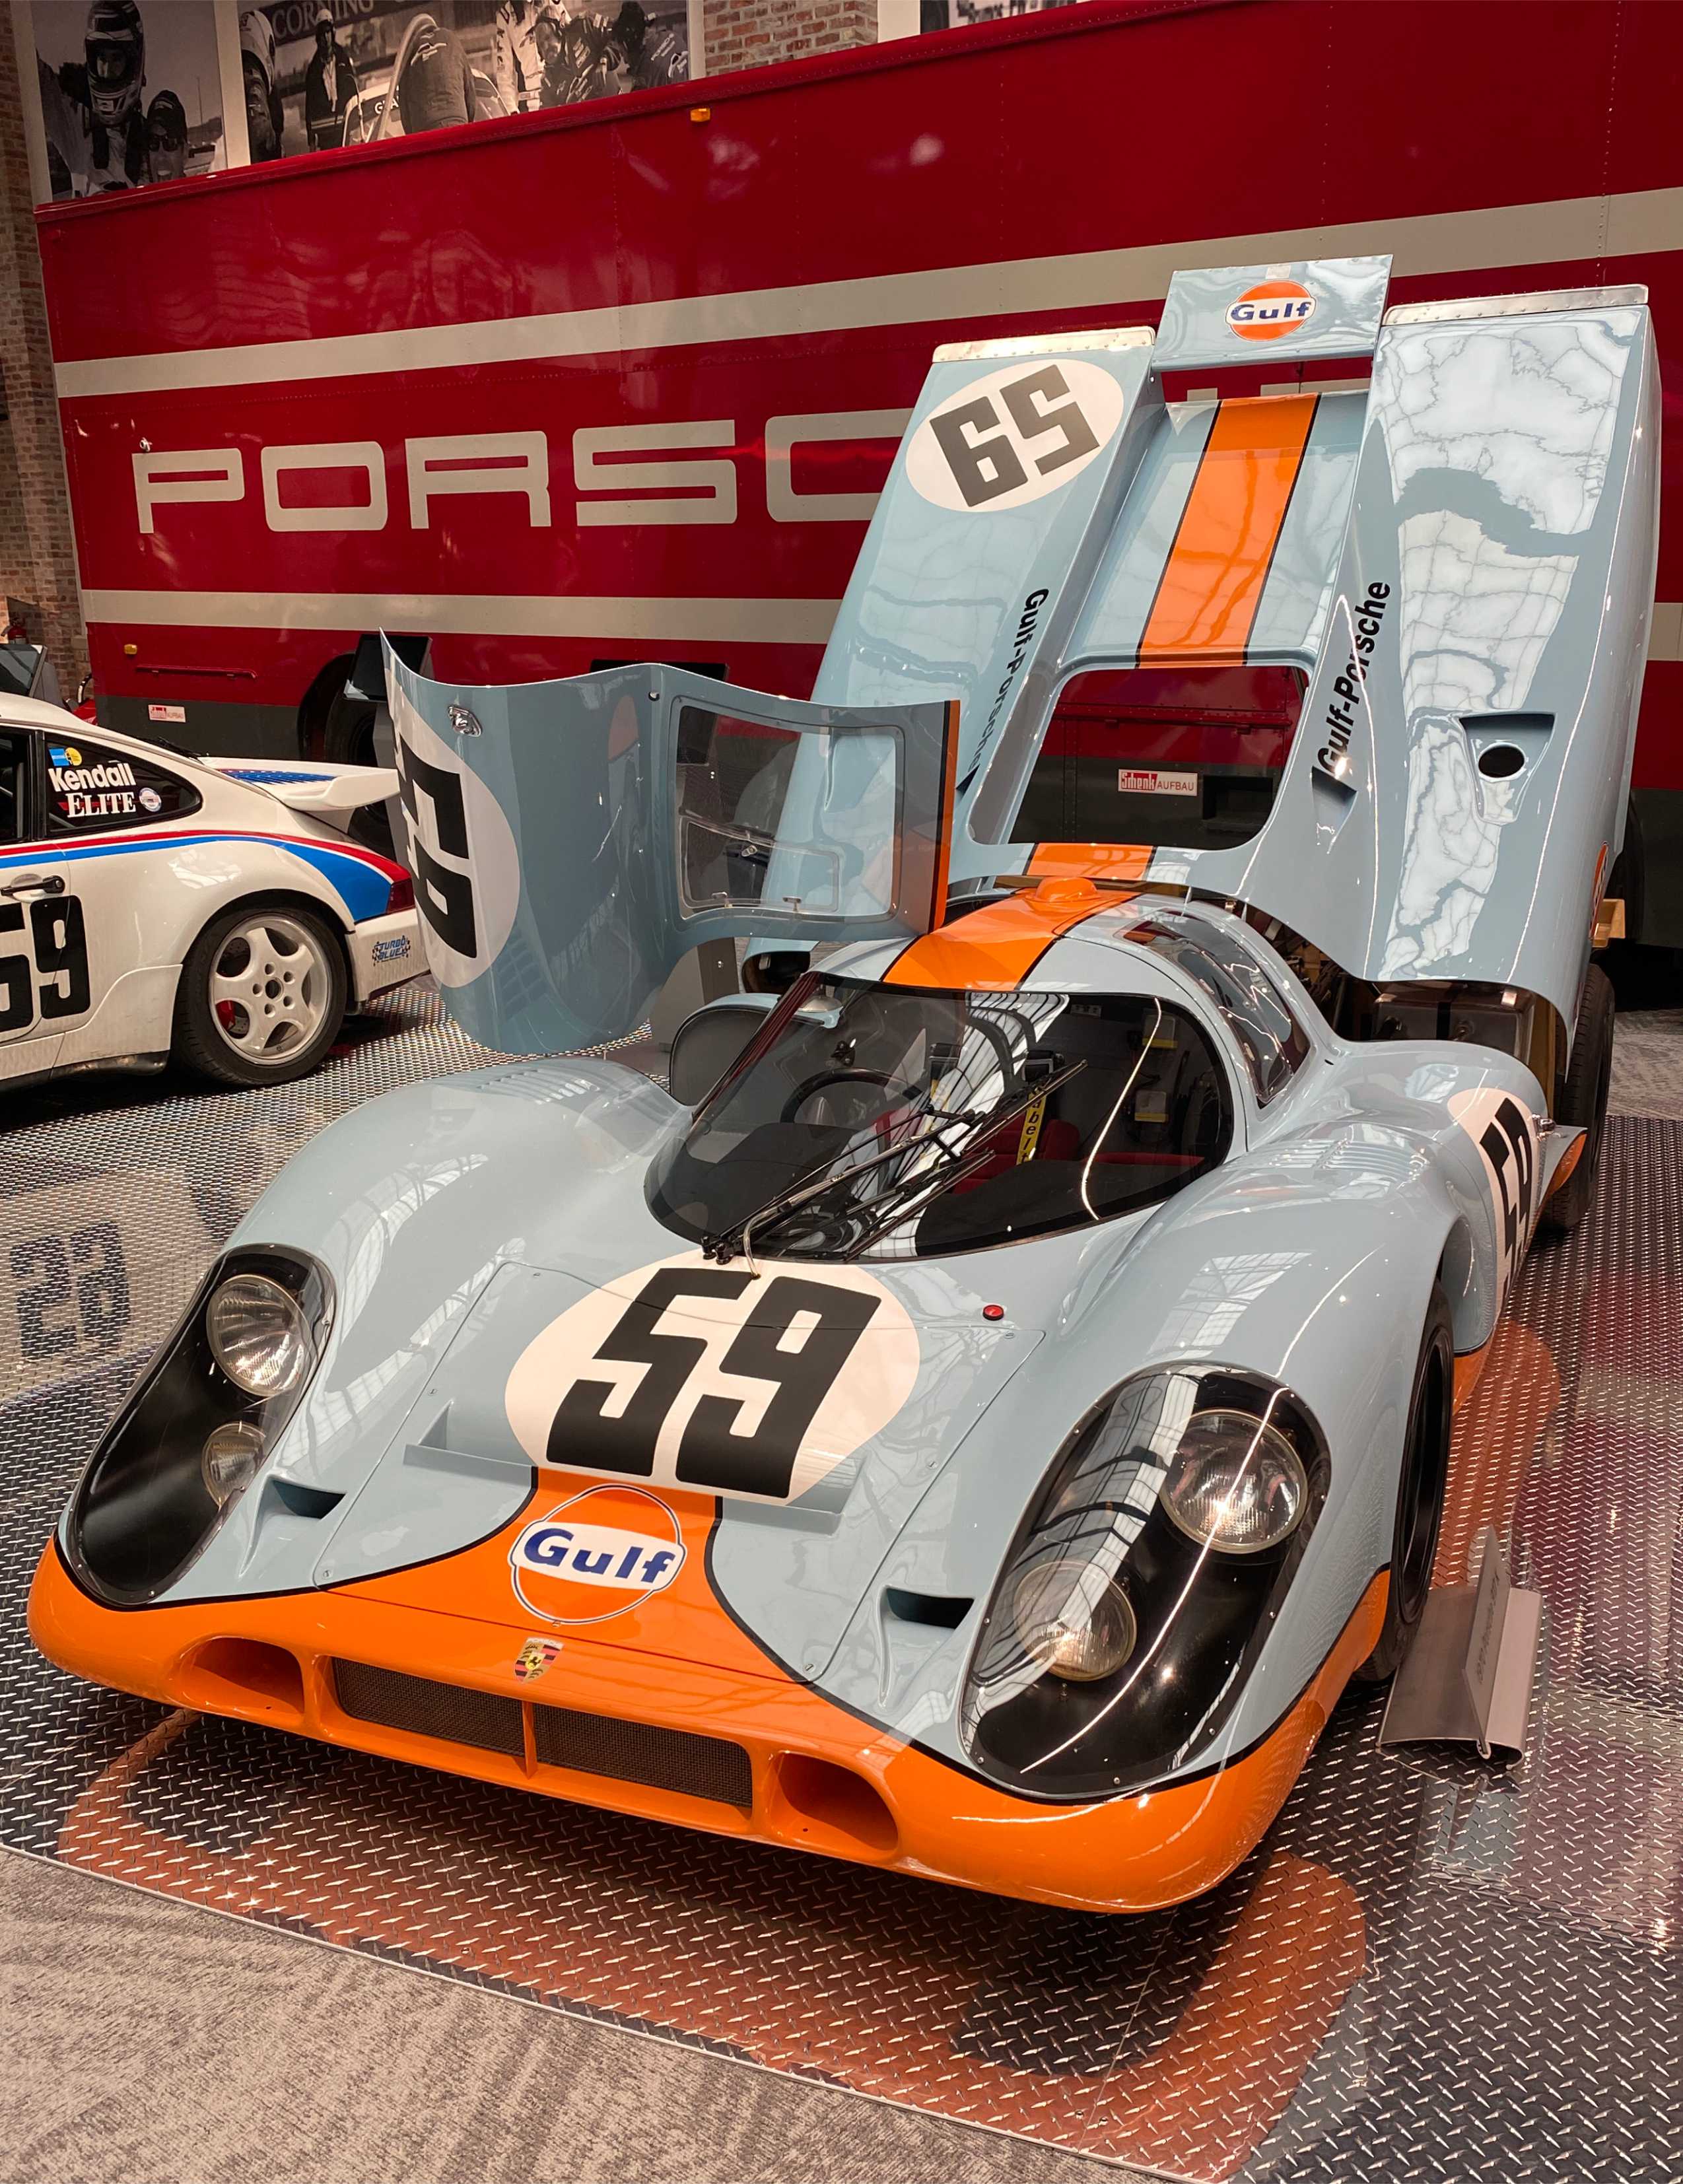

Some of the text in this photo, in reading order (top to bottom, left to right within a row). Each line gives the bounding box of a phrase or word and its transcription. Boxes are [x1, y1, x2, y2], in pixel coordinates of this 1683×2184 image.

[1231, 301, 1312, 322] Gulf
[132, 407, 919, 533] PORSC
[1317, 581, 1391, 778] Gulf-Porsche
[48, 763, 136, 792] Kendall
[1157, 780, 1194, 792] AUFBAU
[65, 792, 136, 818] ELITE
[374, 938, 406, 951] TURBO
[378, 948, 407, 961] BLUE
[546, 1268, 882, 1499] 59
[524, 1527, 676, 1584] Gulf
